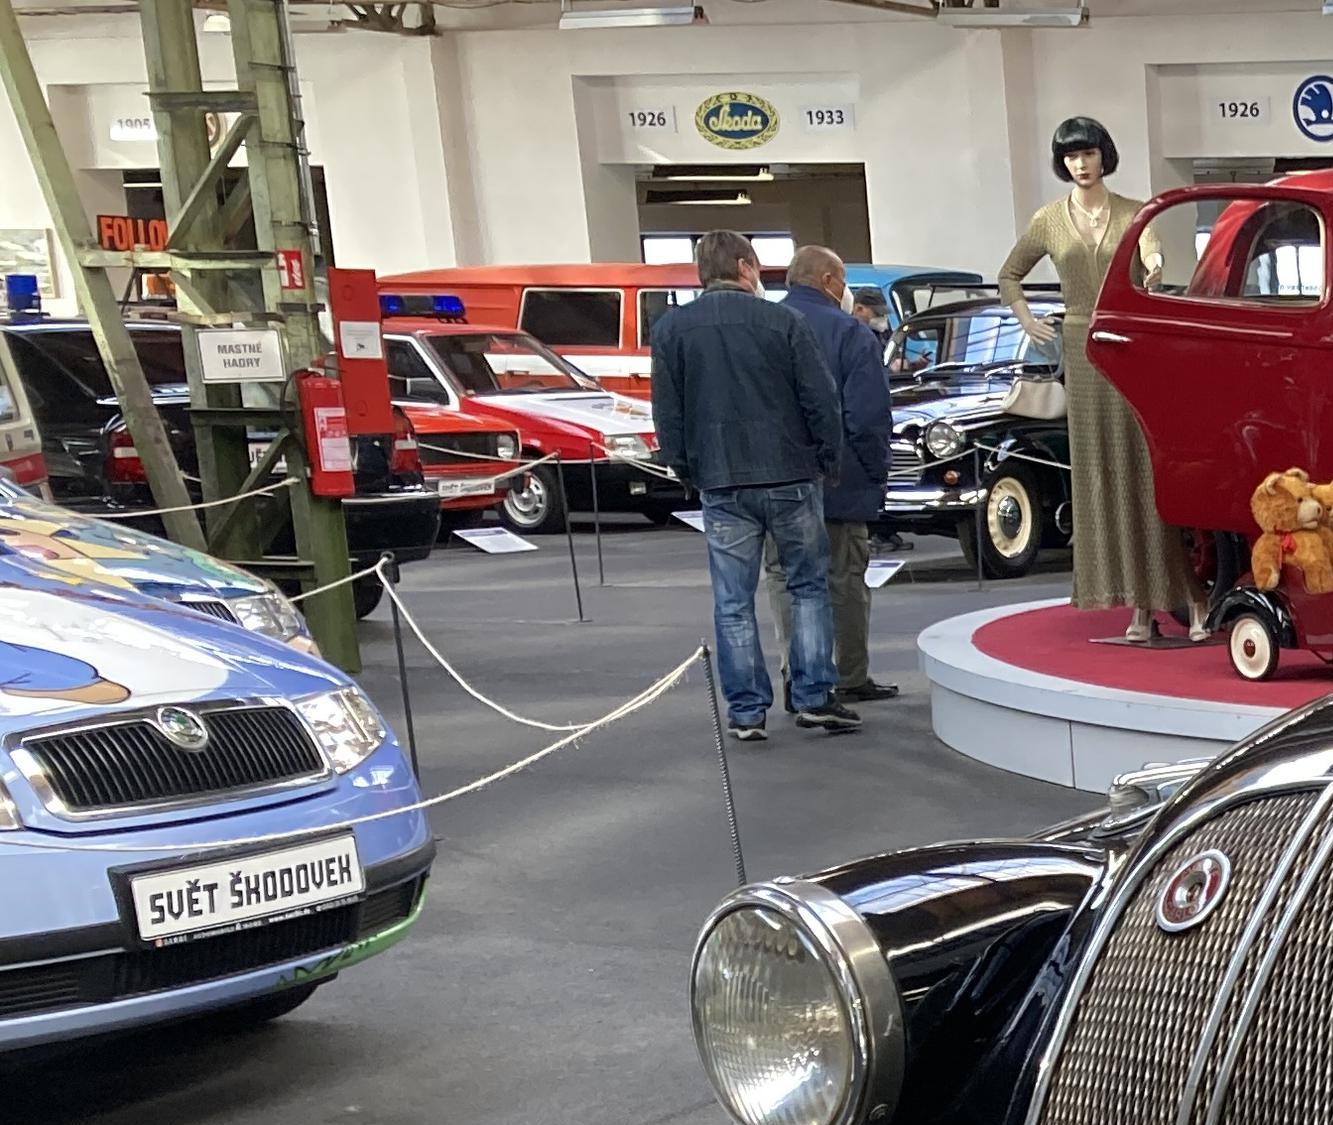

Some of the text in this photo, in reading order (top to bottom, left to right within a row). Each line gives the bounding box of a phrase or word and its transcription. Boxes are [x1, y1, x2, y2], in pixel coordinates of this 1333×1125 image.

[806, 109, 844, 125] 1933
[1218, 102, 1260, 118] 1926
[629, 111, 666, 127] 1926
[100, 217, 168, 251] FOLLO
[150, 853, 353, 925] SVĚT ŠKODOVEK
